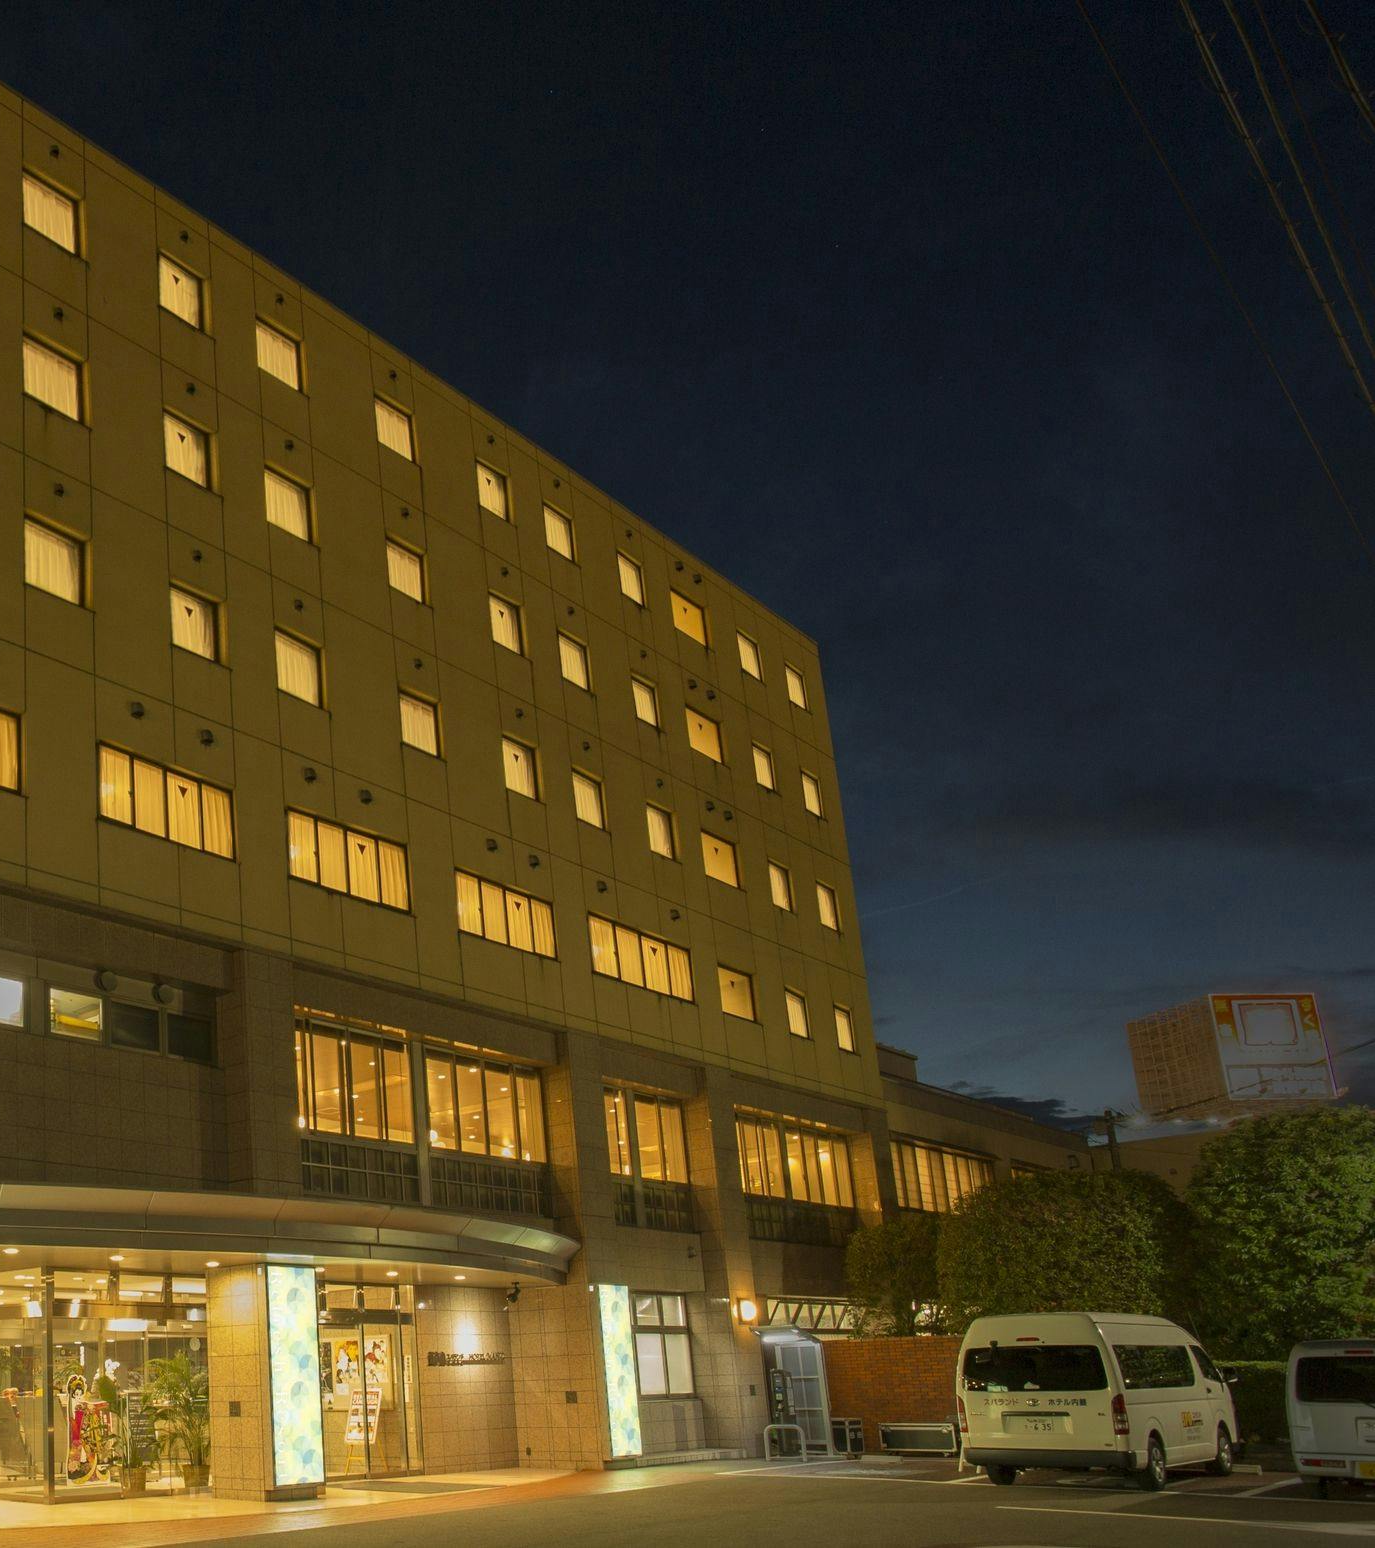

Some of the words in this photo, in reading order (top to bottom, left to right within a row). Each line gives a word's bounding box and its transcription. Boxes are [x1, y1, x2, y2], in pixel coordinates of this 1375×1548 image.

[984, 1398, 1019, 1406] スパランド
